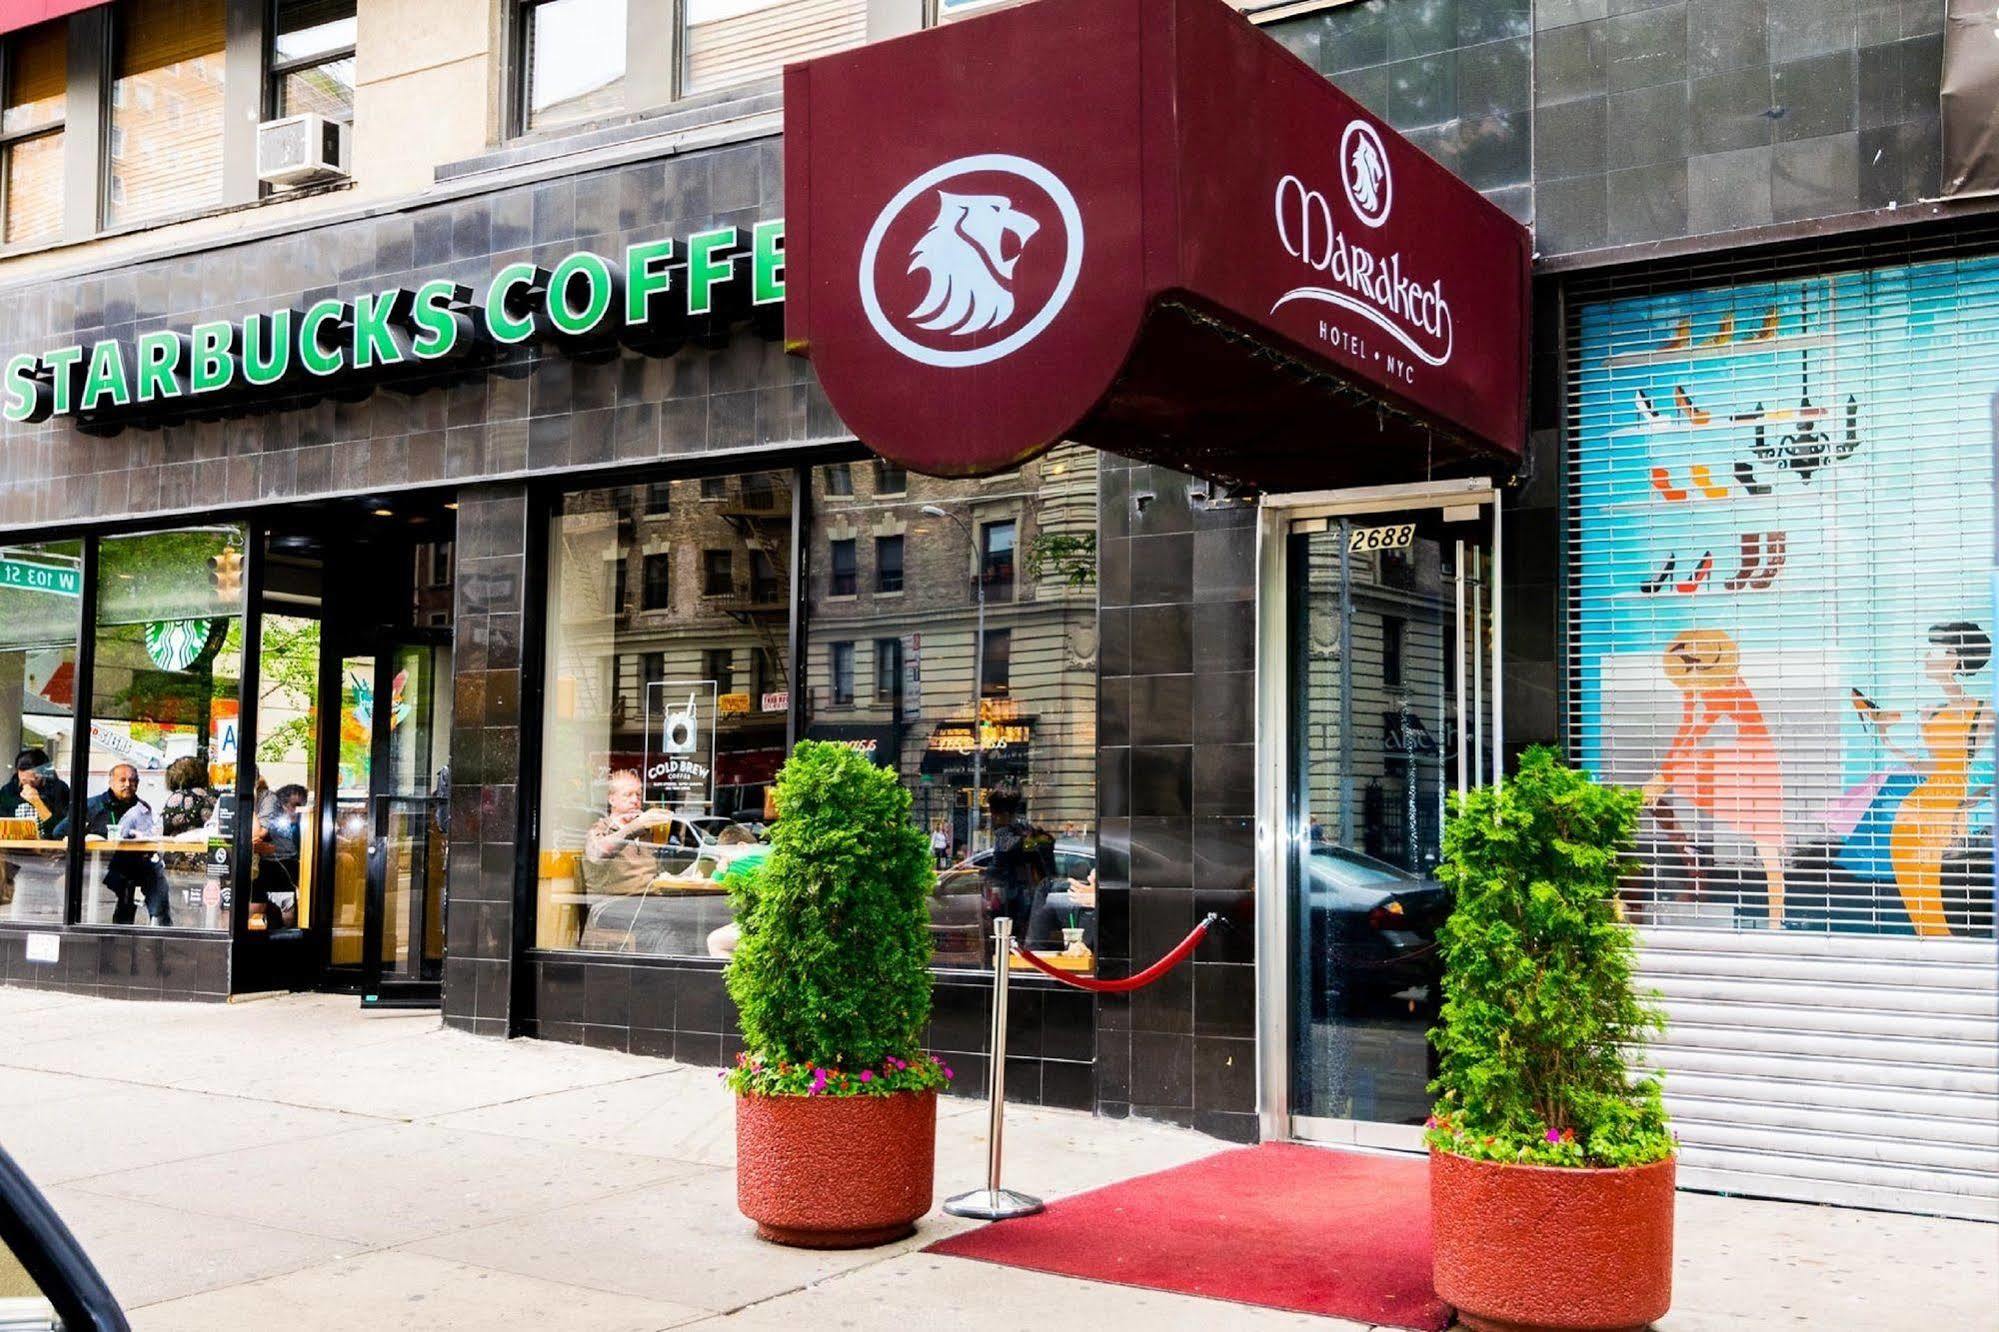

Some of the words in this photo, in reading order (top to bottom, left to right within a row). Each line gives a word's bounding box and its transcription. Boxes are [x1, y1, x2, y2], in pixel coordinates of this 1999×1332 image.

[3, 279, 458, 421] STARBUCKS
[1319, 320, 1366, 359] HOTEL
[1387, 354, 1414, 384] NYC
[1351, 526, 1412, 551] 2688
[222, 725, 236, 751] A
[648, 760, 679, 780] COLD
[680, 760, 710, 779] BREW
